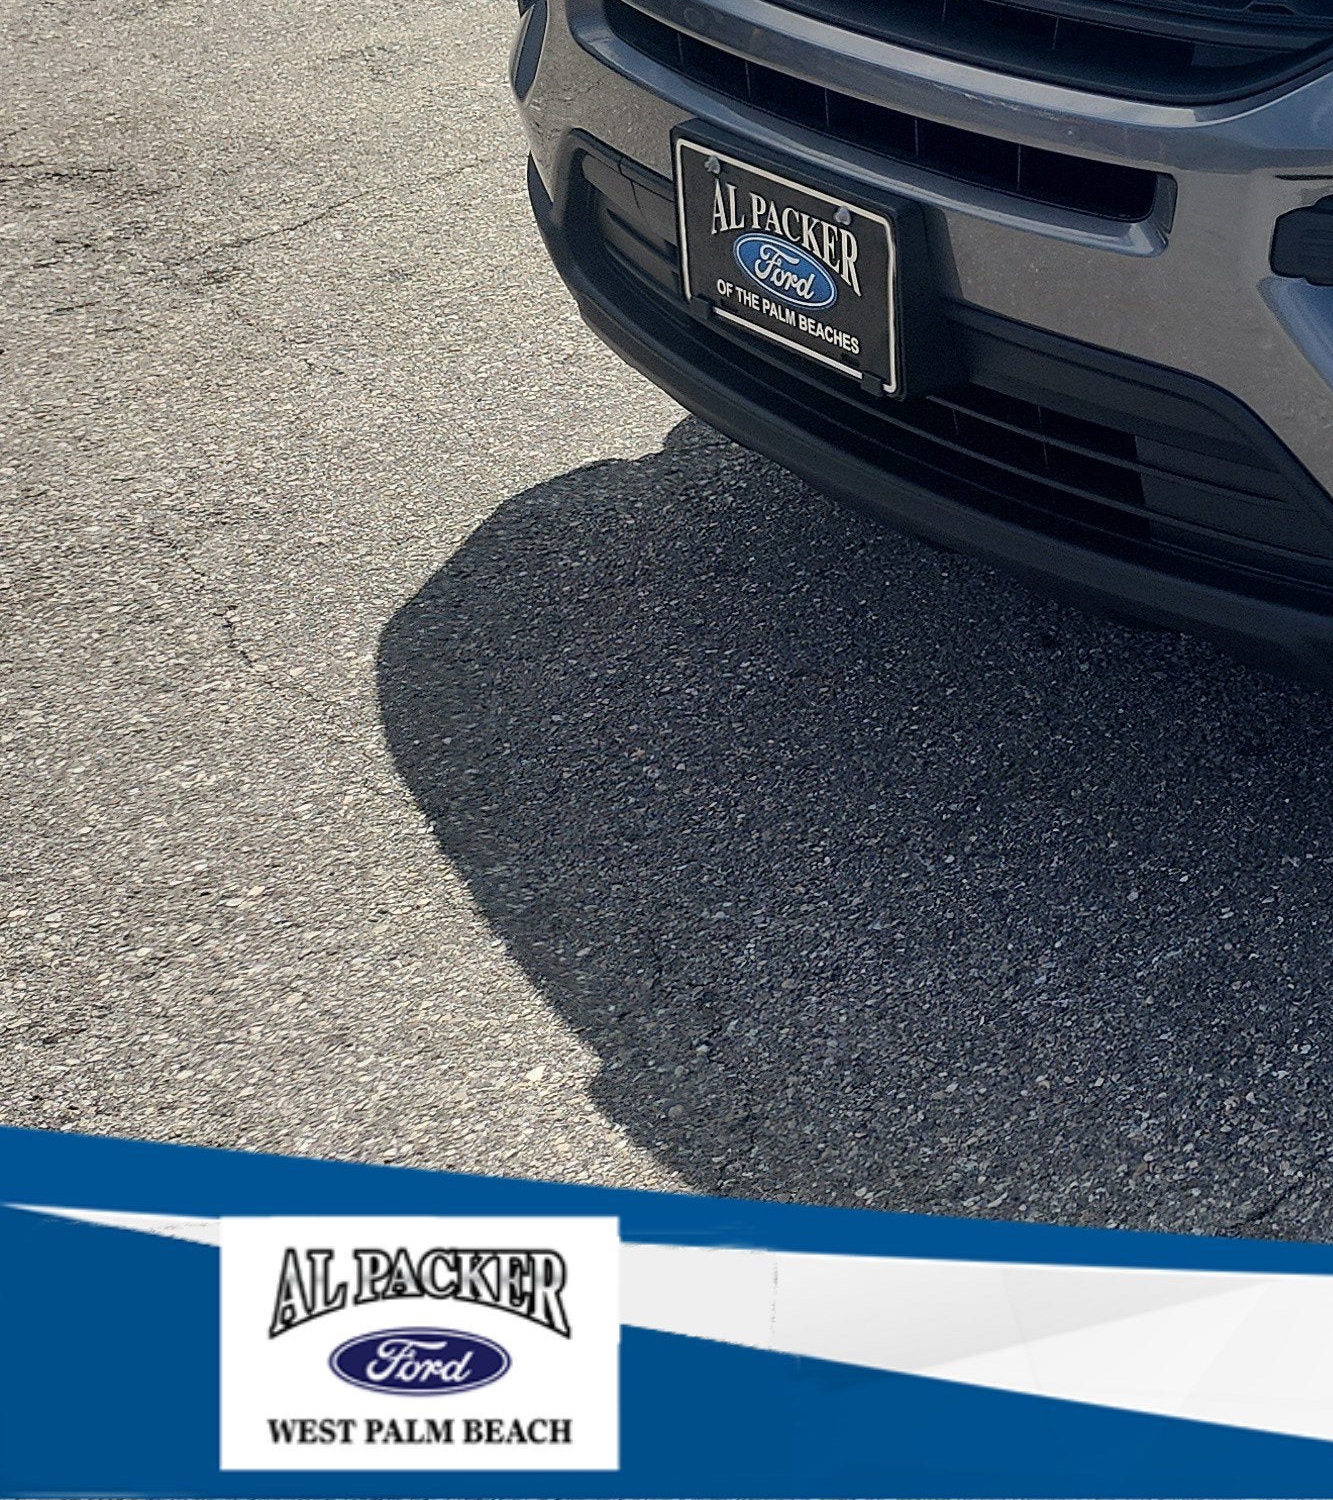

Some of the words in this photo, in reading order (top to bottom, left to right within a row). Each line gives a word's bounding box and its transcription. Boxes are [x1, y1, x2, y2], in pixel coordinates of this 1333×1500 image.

[711, 177, 745, 235] AL
[749, 191, 862, 297] PACKER
[754, 243, 816, 300] Ford
[716, 278, 734, 296] OF
[735, 285, 760, 311] THE
[762, 299, 796, 327] PALM
[798, 314, 861, 355] BEACHES
